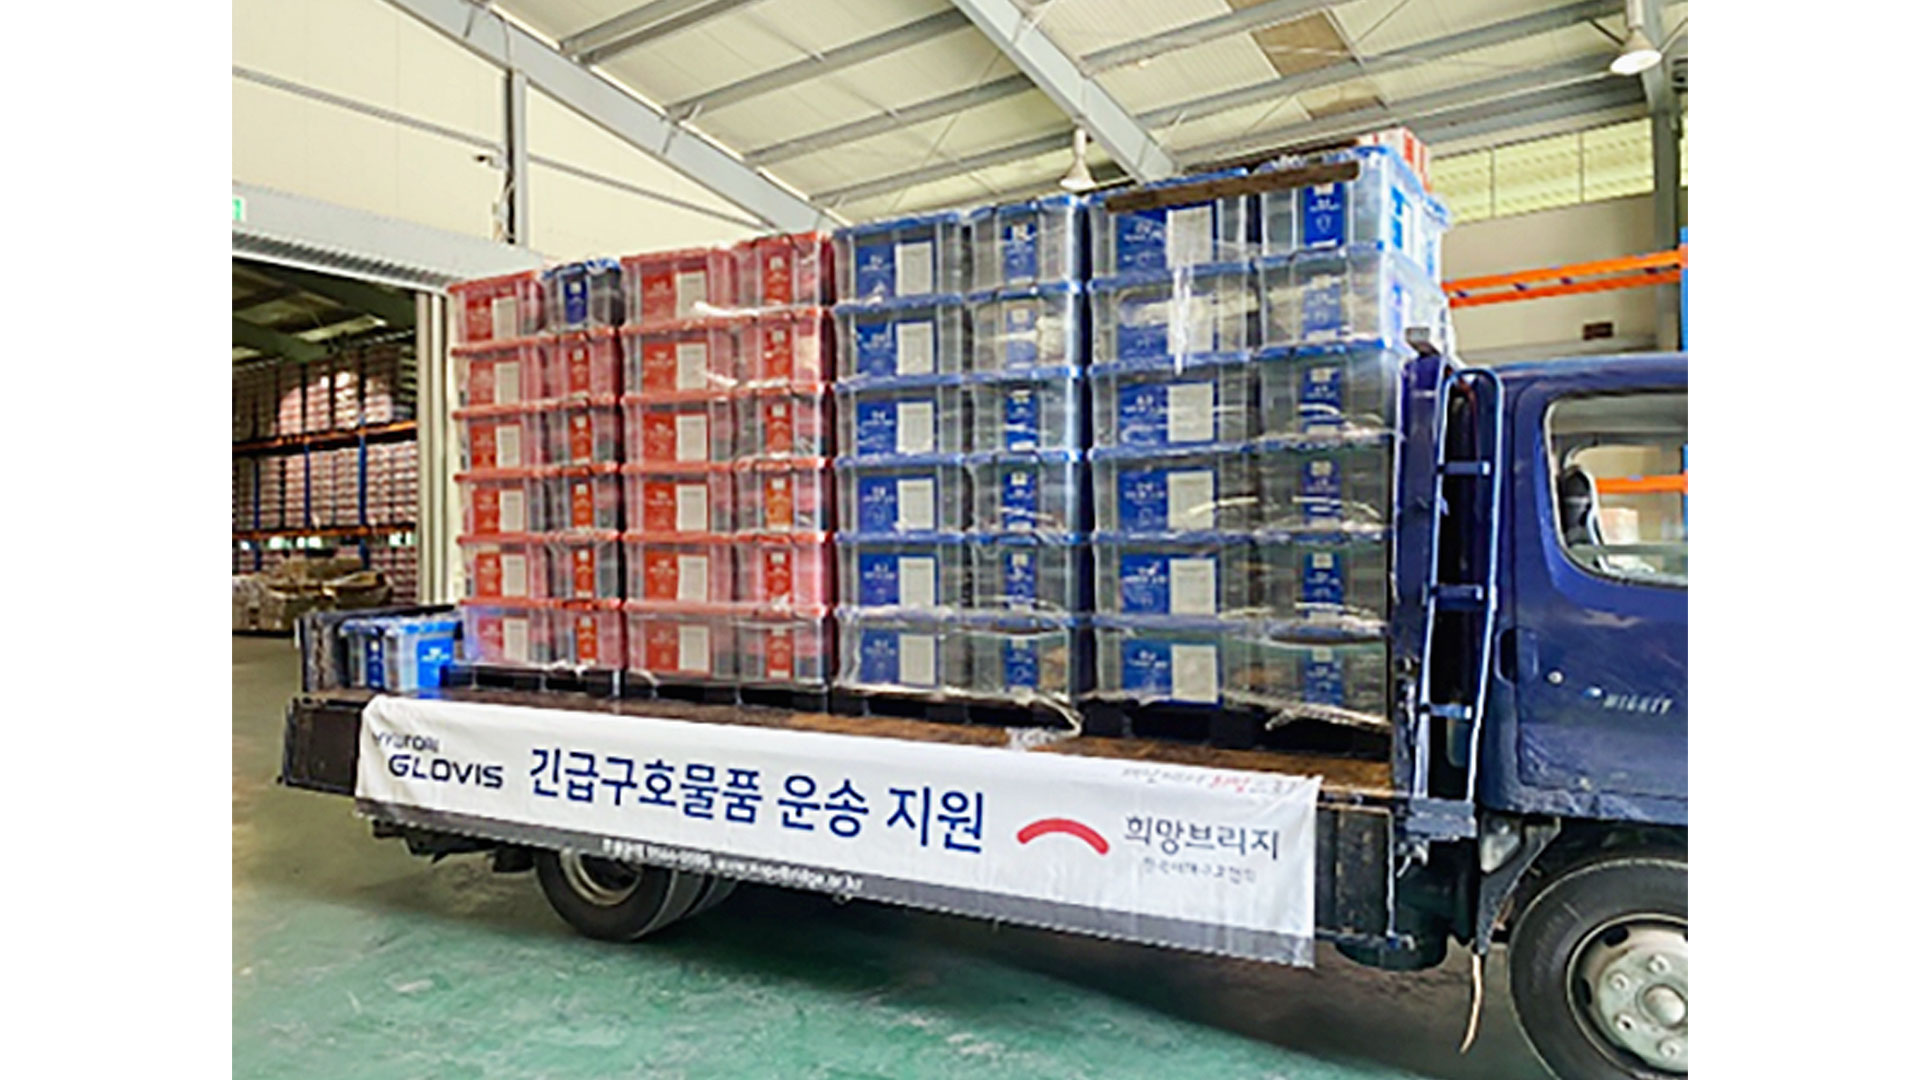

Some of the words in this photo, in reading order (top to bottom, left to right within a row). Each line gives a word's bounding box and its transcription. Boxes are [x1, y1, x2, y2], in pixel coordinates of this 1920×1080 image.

[387, 753, 504, 790] GLOVIS
[529, 747, 763, 824] 긴급구호물품
[777, 773, 870, 839] 운송
[886, 785, 985, 855] 지원
[1124, 815, 1280, 861] 희망브리지
